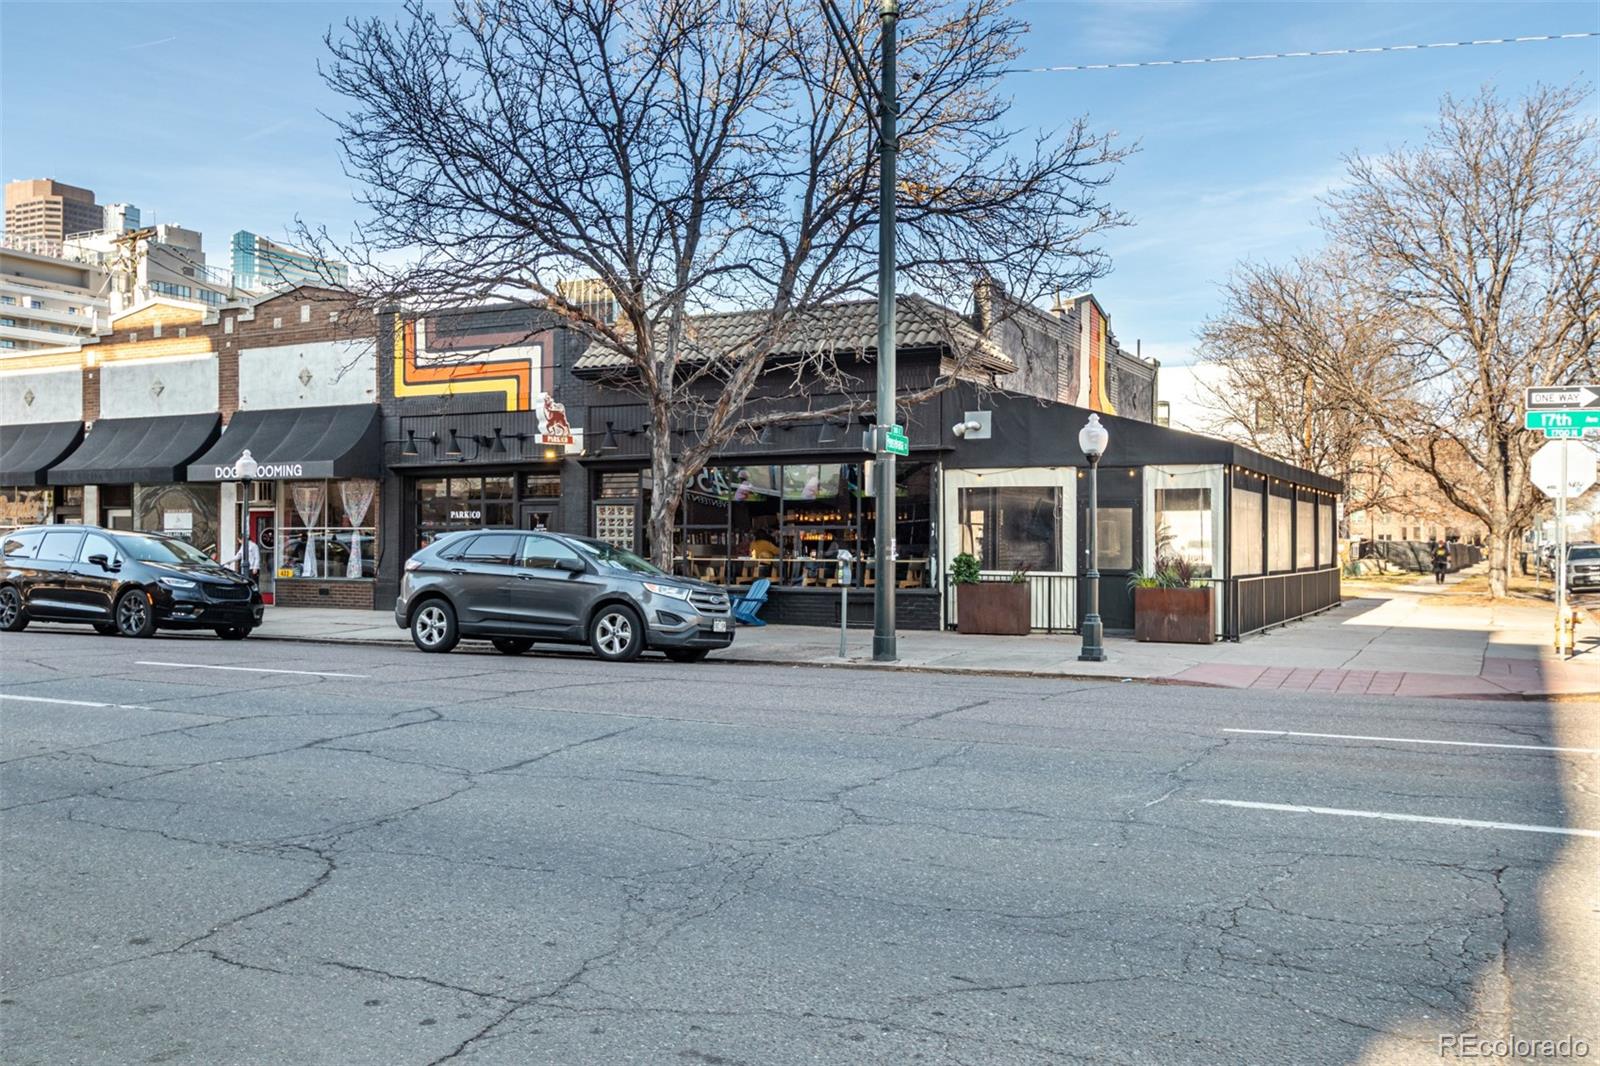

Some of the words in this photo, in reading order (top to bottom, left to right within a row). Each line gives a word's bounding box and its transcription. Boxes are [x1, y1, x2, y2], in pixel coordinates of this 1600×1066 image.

[1535, 394, 1554, 402] ONE
[1560, 393, 1580, 401] WAY
[1541, 413, 1572, 426] 17th
[254, 464, 303, 478] OOMING
